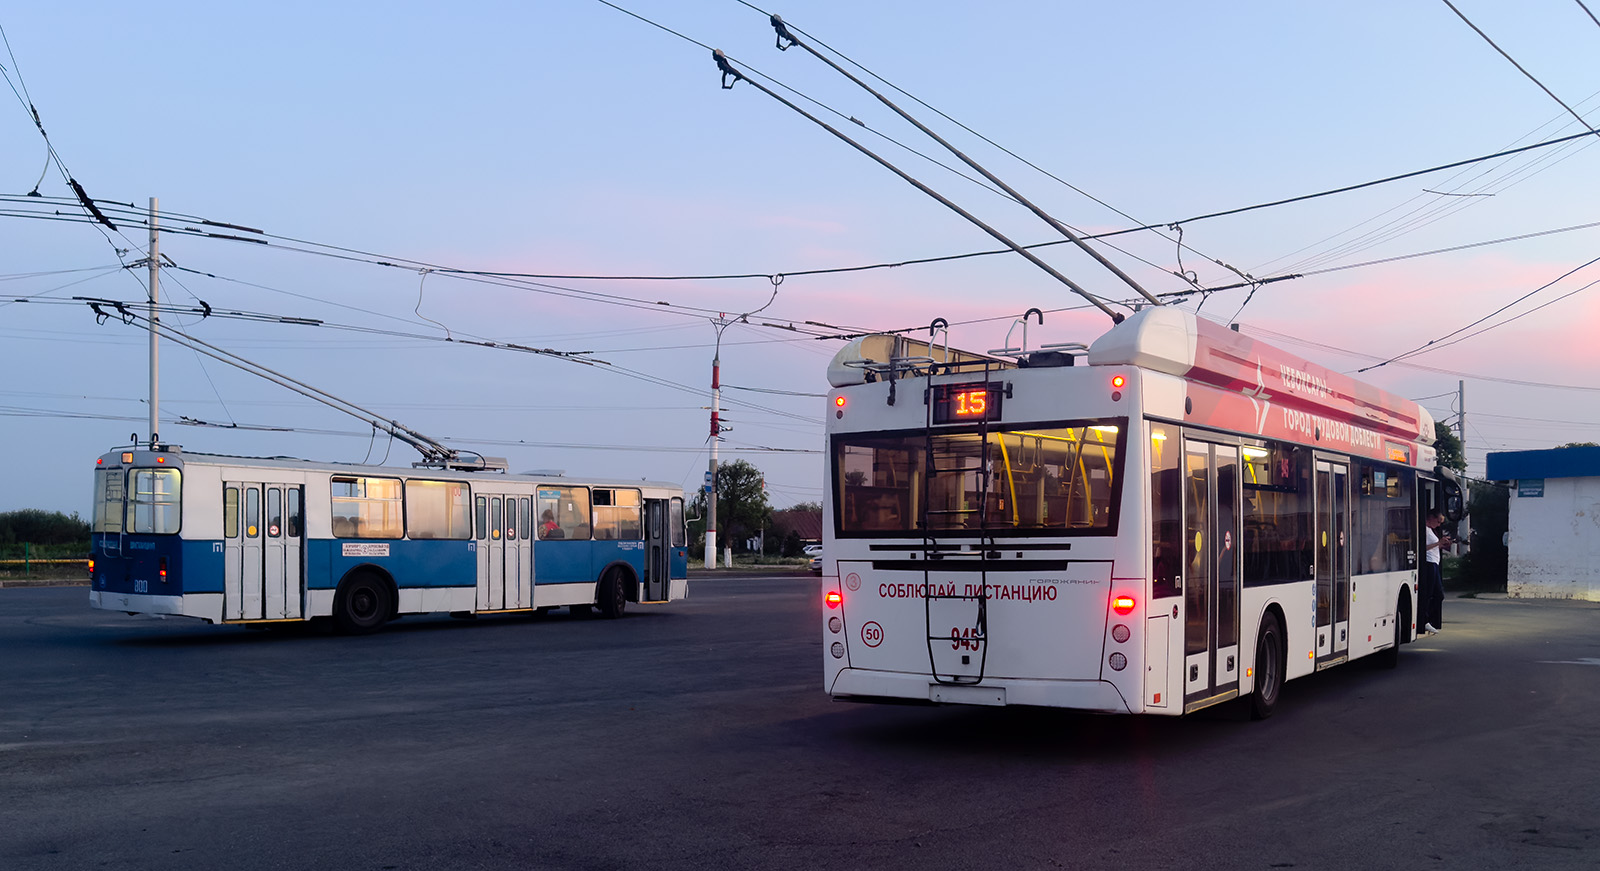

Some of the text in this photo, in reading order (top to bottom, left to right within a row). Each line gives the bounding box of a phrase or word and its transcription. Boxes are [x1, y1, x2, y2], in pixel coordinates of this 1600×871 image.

[1280, 364, 1327, 399] ЧЕБОКСАРЫ
[957, 391, 986, 414] 15
[1283, 408, 1381, 450] ГОРОД ТРУДОВОЙ ДОБЛЕСТИ
[879, 581, 1057, 603] СОБЛЮДАЙ ДИСТАНЦИЮ
[866, 629, 880, 640] 50
[952, 627, 980, 651] 945
